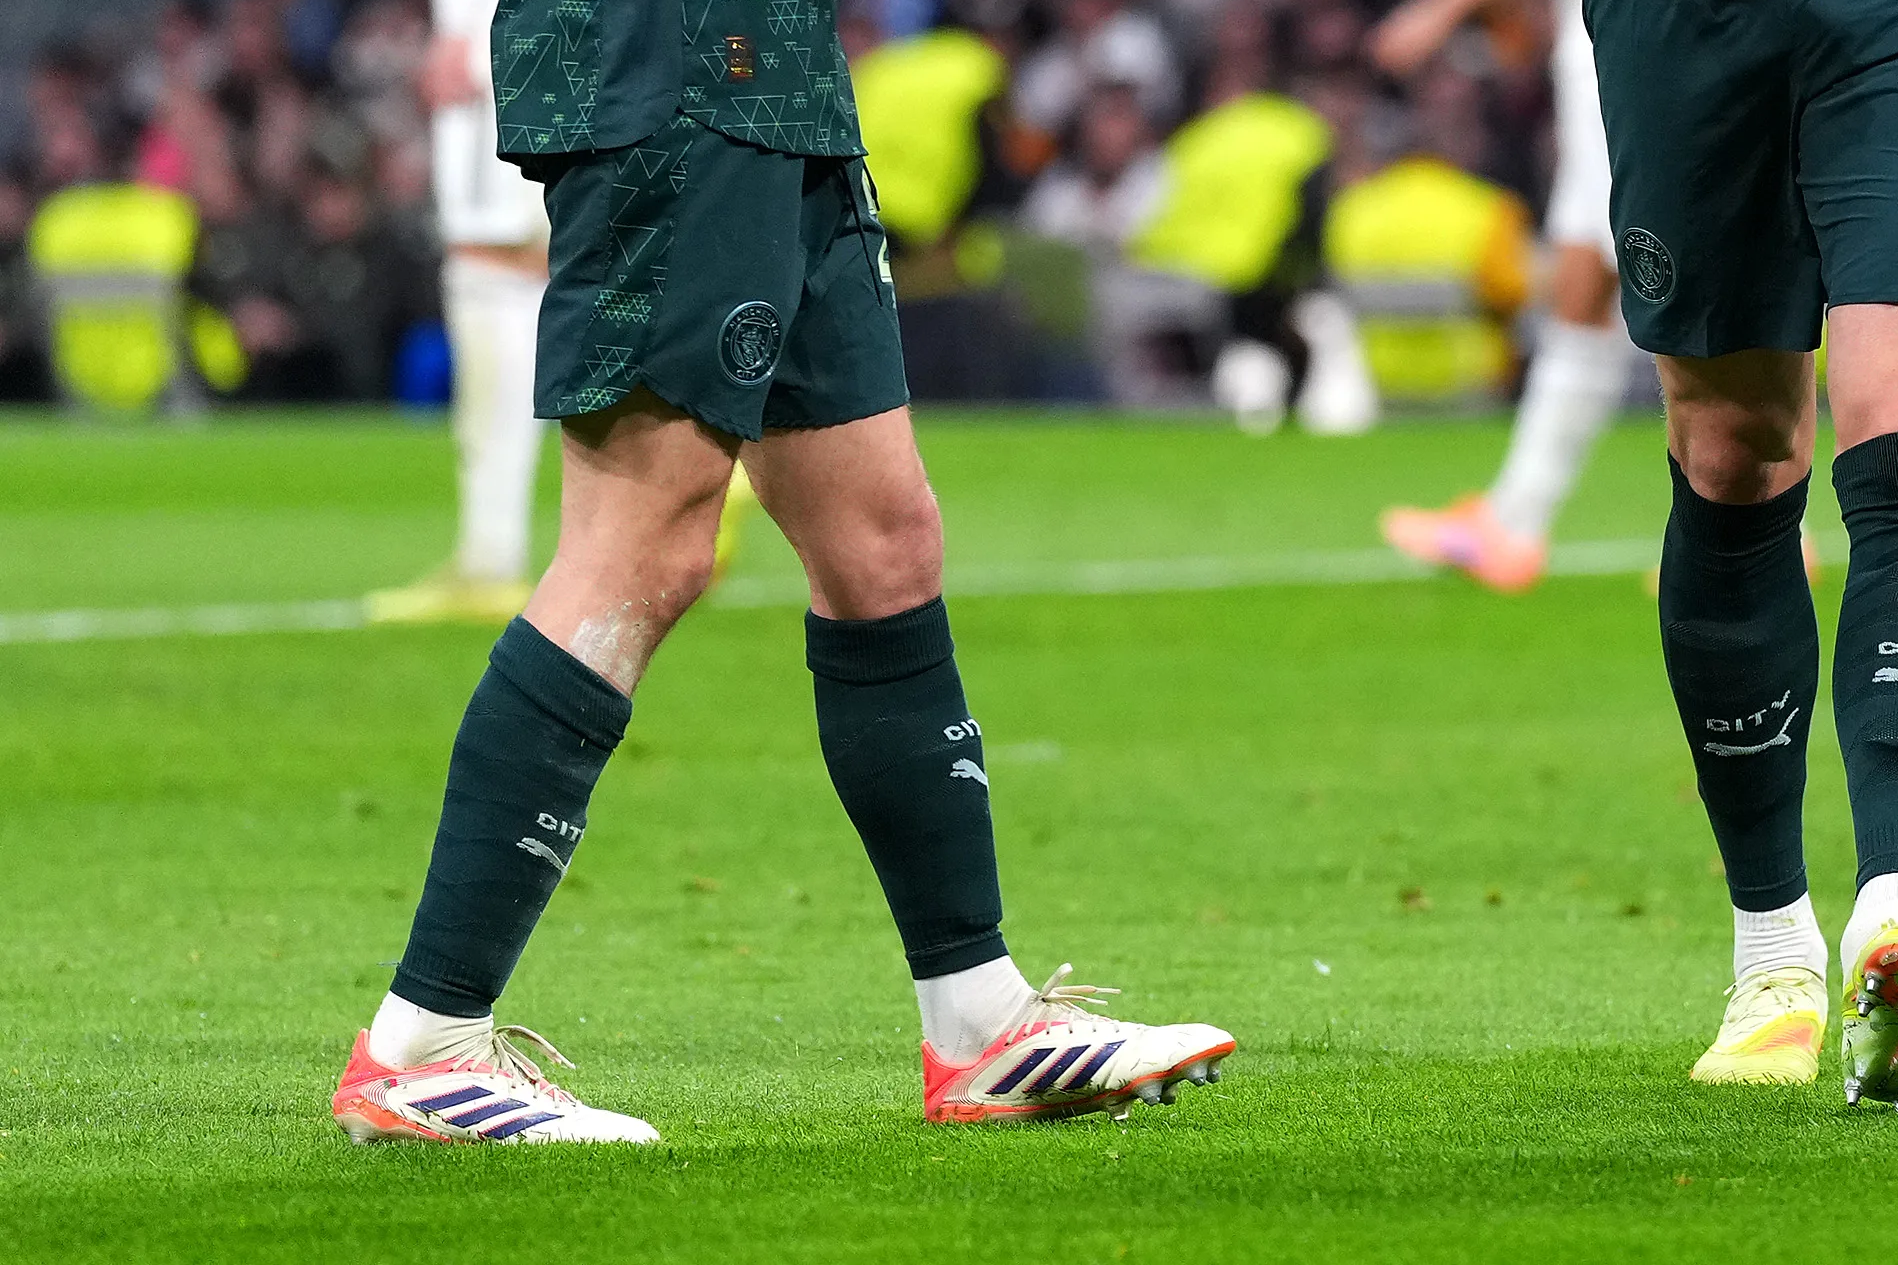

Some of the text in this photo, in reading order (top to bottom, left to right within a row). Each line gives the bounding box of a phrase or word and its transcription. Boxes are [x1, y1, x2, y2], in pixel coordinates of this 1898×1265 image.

[1706, 689, 1791, 732] CITY
[943, 719, 982, 741] CIT
[536, 813, 584, 843] CIT
